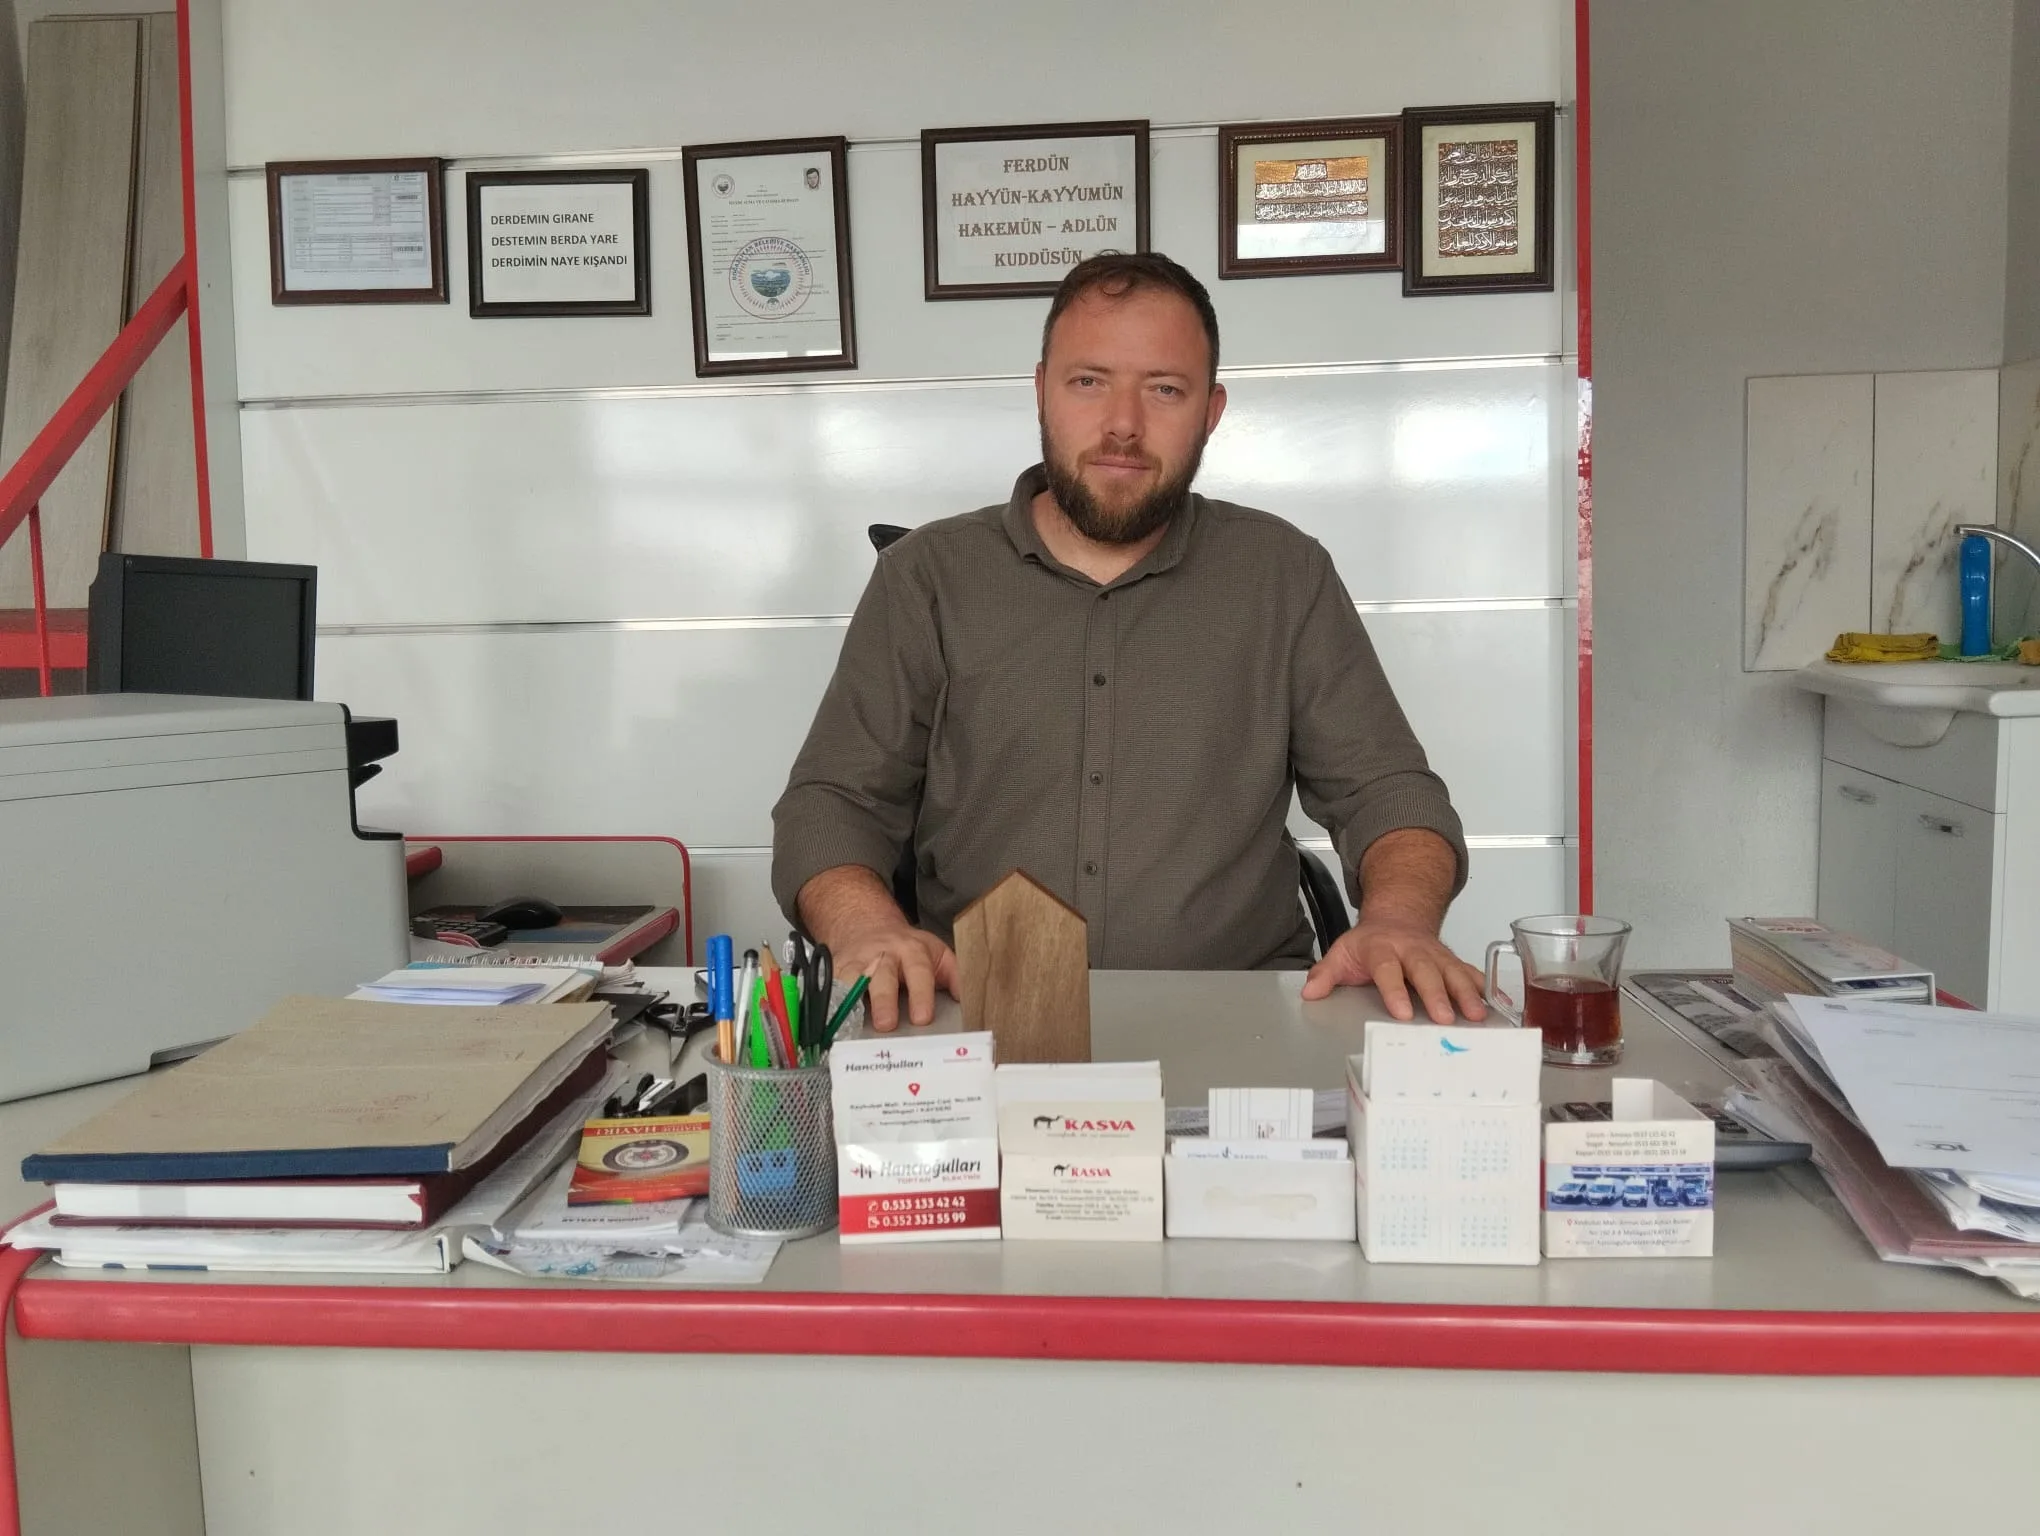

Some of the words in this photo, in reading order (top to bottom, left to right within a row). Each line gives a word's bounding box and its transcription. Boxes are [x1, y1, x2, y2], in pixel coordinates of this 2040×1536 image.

[1003, 154, 1069, 173] FERDÜN
[491, 214, 549, 225] DERDEMIN
[552, 213, 595, 224] GIRANE
[958, 217, 1042, 238] HAKEMÜN
[1060, 215, 1118, 233] ADLÜN
[491, 235, 547, 247] DESTEMIN
[550, 235, 588, 245] BERDA
[590, 234, 619, 244] YARE
[550, 256, 581, 266] NAYE
[583, 255, 627, 267] KIŞANDI
[994, 247, 1083, 267] KUDDÜSÜN
[1064, 1119, 1136, 1131] KASVA
[1071, 1167, 1112, 1177] KASVA
[882, 1198, 912, 1211] 0.533
[914, 1198, 934, 1210] 133
[936, 1197, 950, 1208] 42
[952, 1196, 966, 1208] 42
[882, 1214, 912, 1227] 0.352
[914, 1213, 935, 1226] 332
[936, 1212, 950, 1224] 55
[952, 1211, 966, 1223] 99
